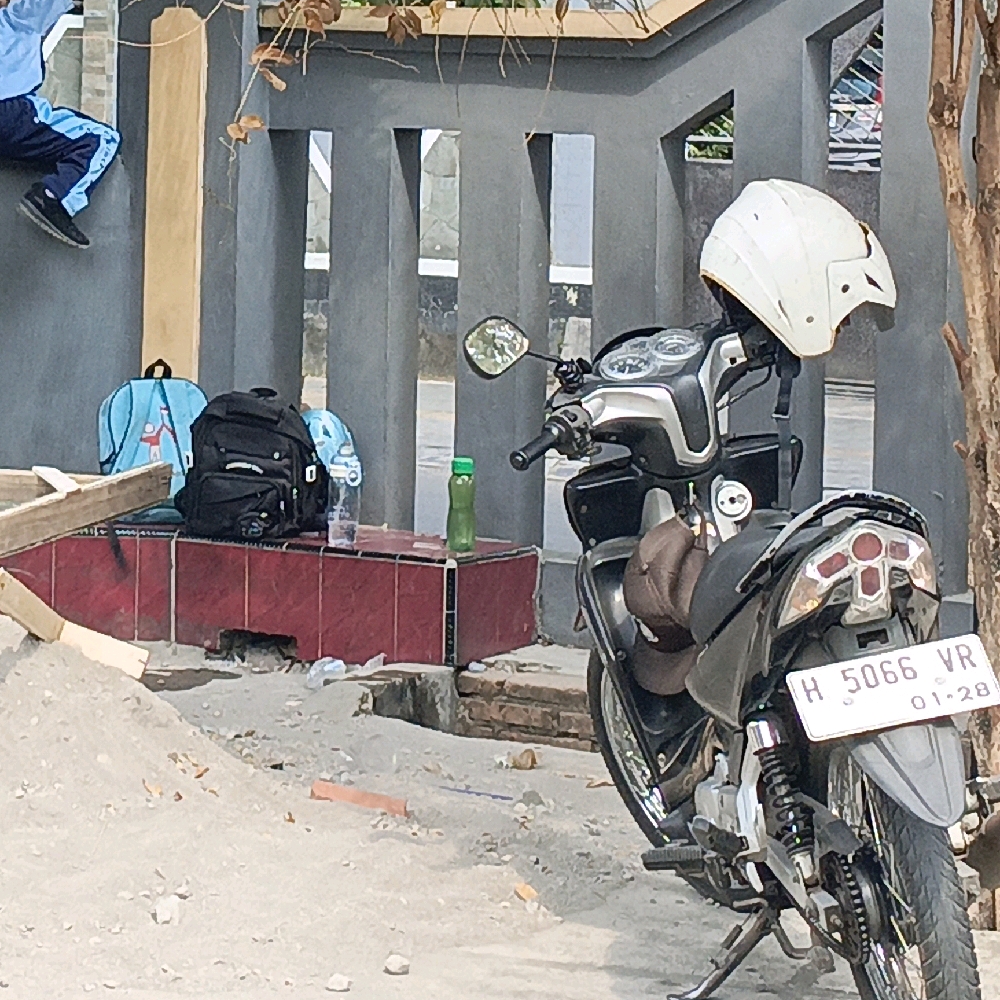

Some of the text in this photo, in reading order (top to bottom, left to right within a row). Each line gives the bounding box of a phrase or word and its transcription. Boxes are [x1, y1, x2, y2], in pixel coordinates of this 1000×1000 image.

[801, 643, 977, 704] H 5066 VR
